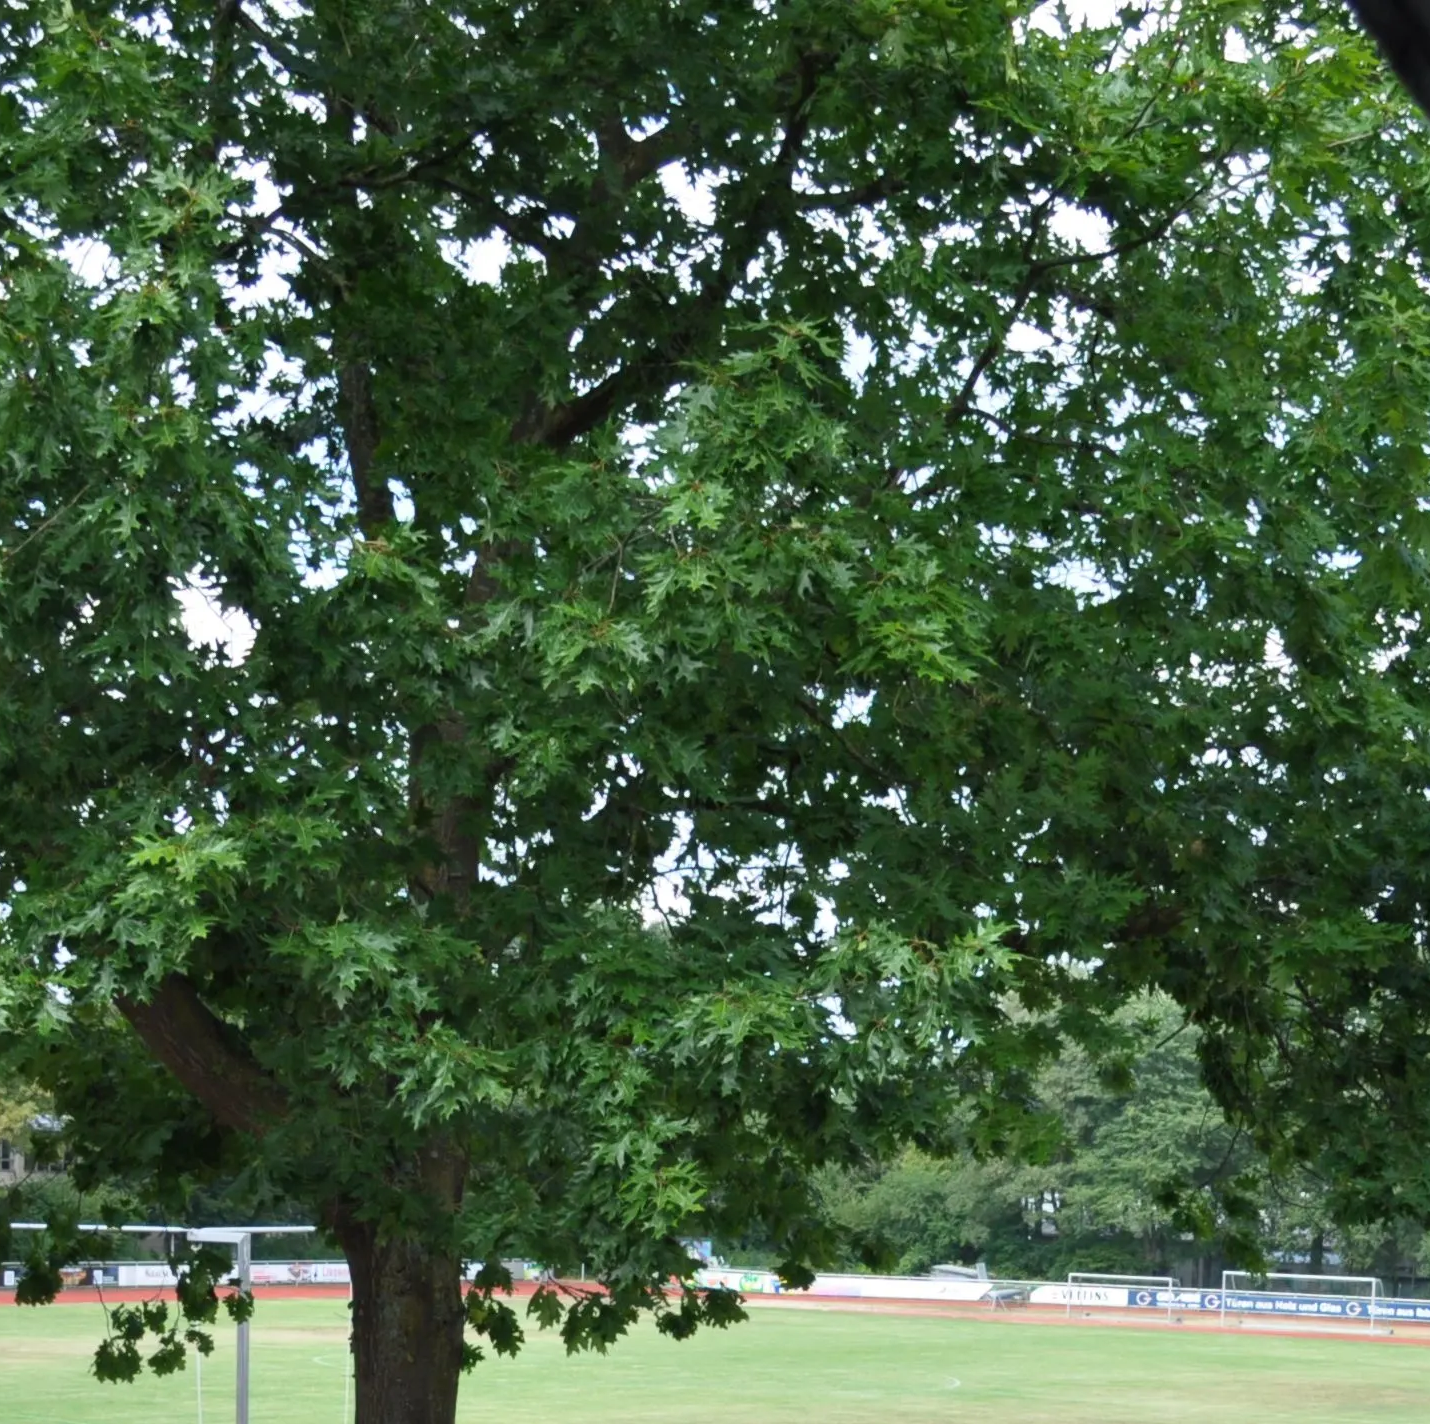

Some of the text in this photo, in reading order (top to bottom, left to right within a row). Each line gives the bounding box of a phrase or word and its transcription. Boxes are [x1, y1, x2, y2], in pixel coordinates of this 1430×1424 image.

[1226, 1298, 1253, 1310] Türen
[1255, 1301, 1273, 1310] aus
[1275, 1300, 1296, 1311] Holz
[1299, 1302, 1317, 1312] und
[1320, 1302, 1342, 1313] Glas
[1367, 1304, 1394, 1316] Türen
[1396, 1308, 1414, 1317] aus
